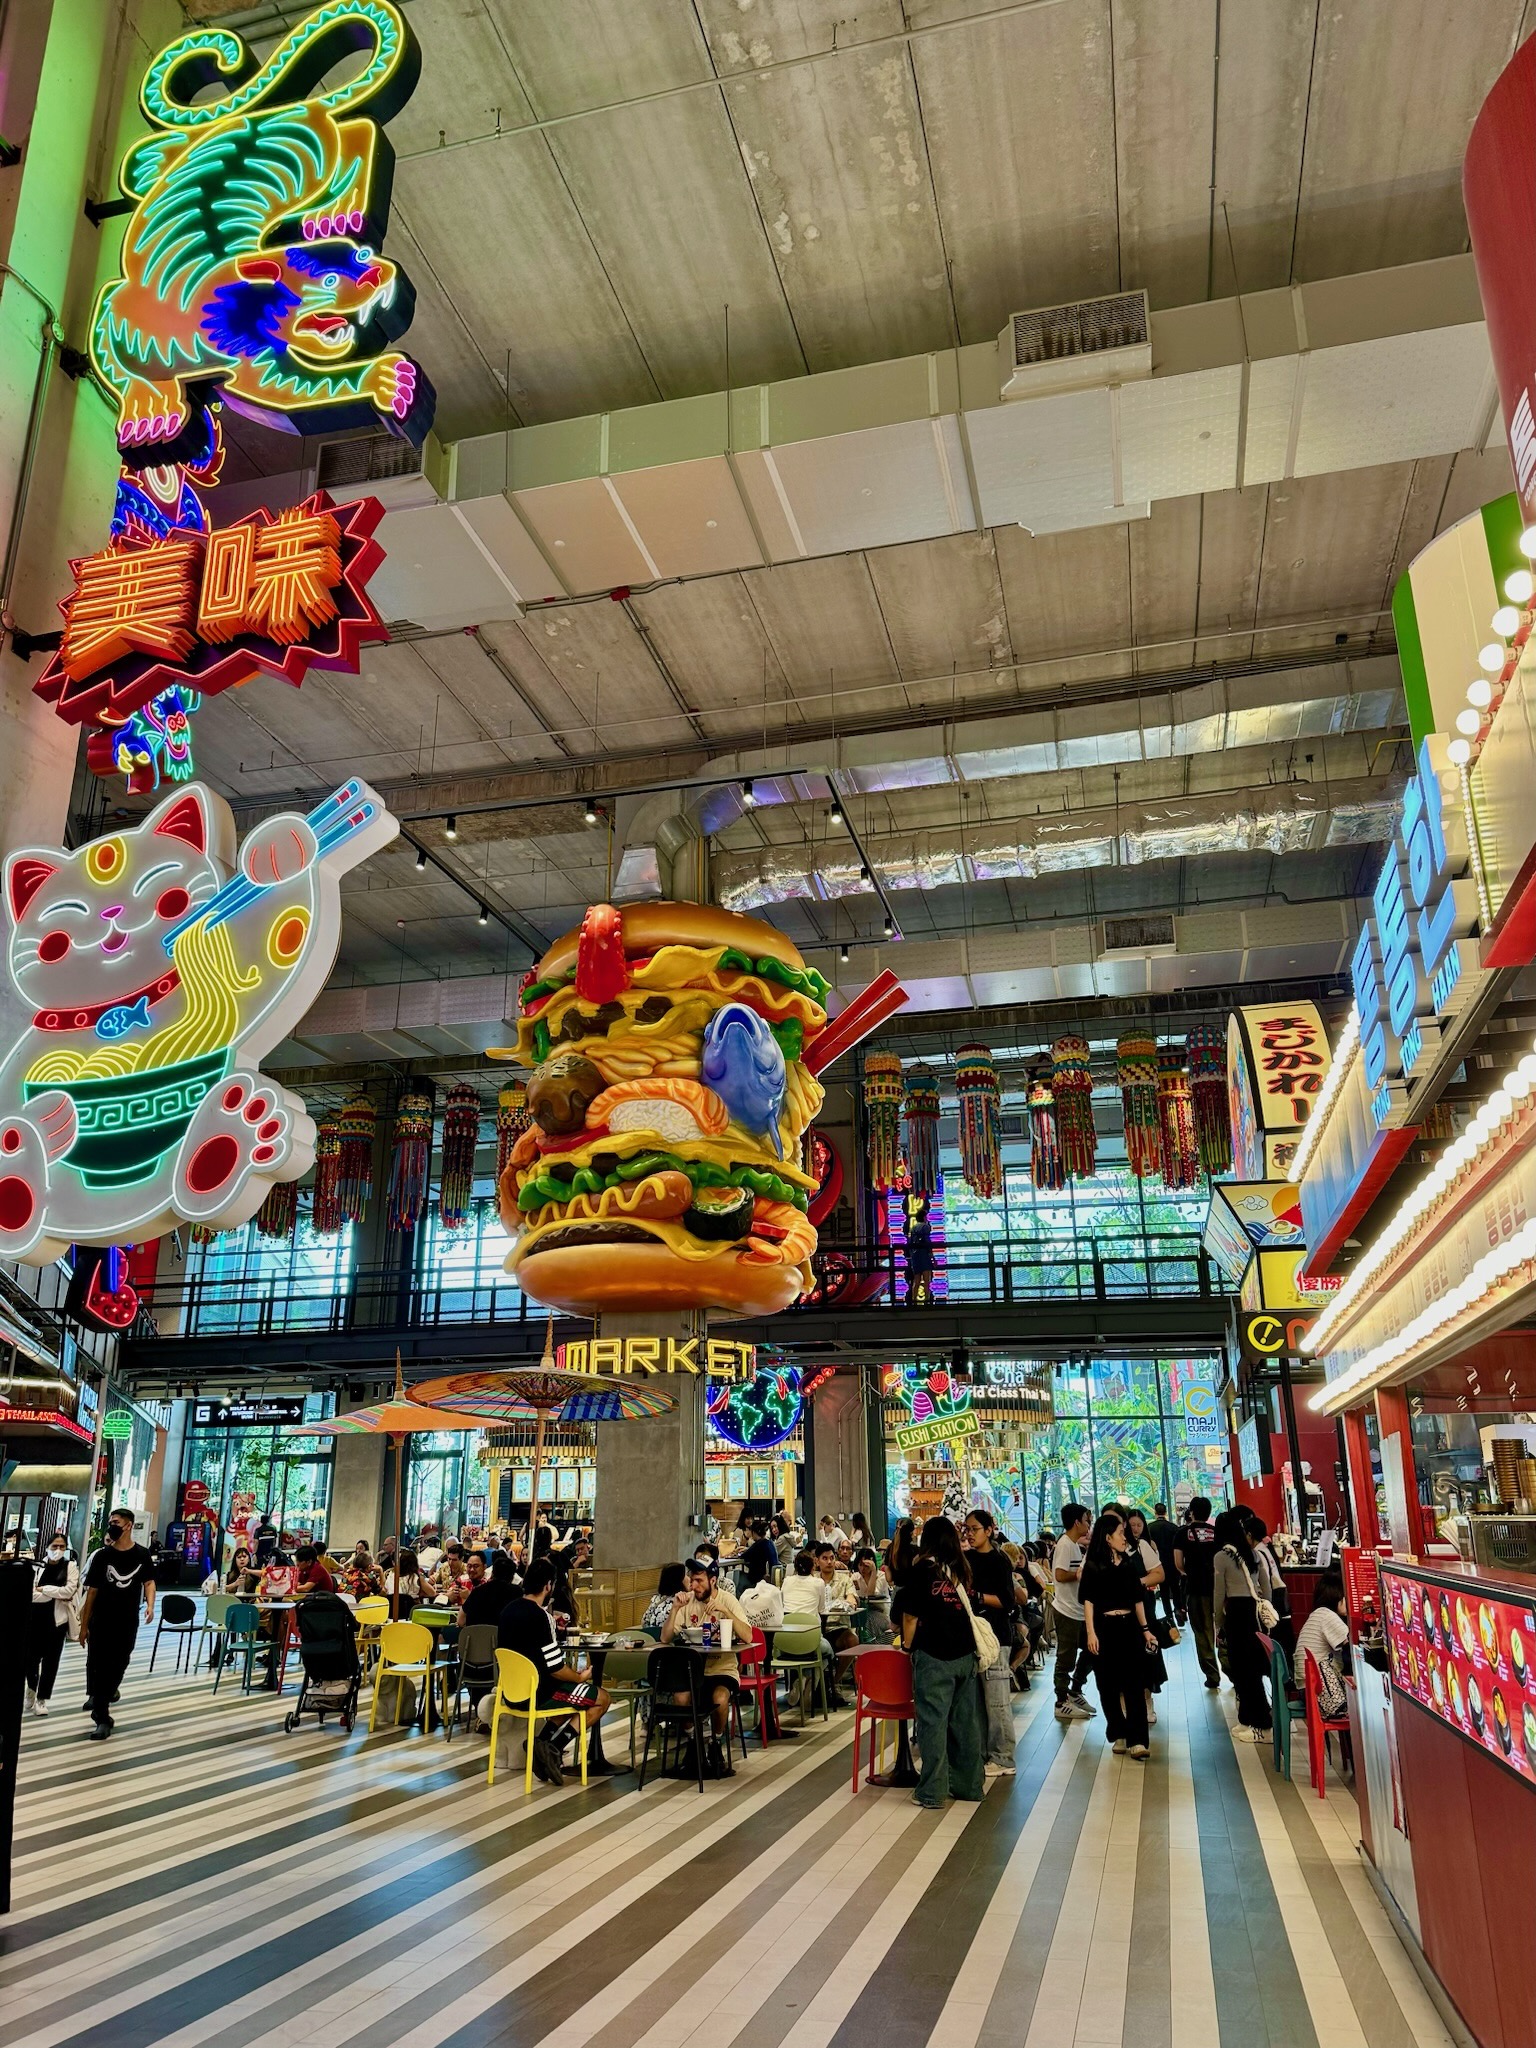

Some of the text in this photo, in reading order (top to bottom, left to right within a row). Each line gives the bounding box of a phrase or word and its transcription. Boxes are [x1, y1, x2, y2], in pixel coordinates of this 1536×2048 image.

[63, 507, 342, 676] 美味
[1370, 940, 1461, 1130] TONG TONG HAAN
[1255, 1016, 1325, 1124] まじかれー
[565, 1336, 754, 1378] MARKET
[987, 1386, 1019, 1399] Class
[1019, 1388, 1039, 1400] Thai
[195, 1405, 211, 1422] G
[900, 1416, 976, 1447] SUSHI STATION
[1187, 1416, 1217, 1425] MAJI
